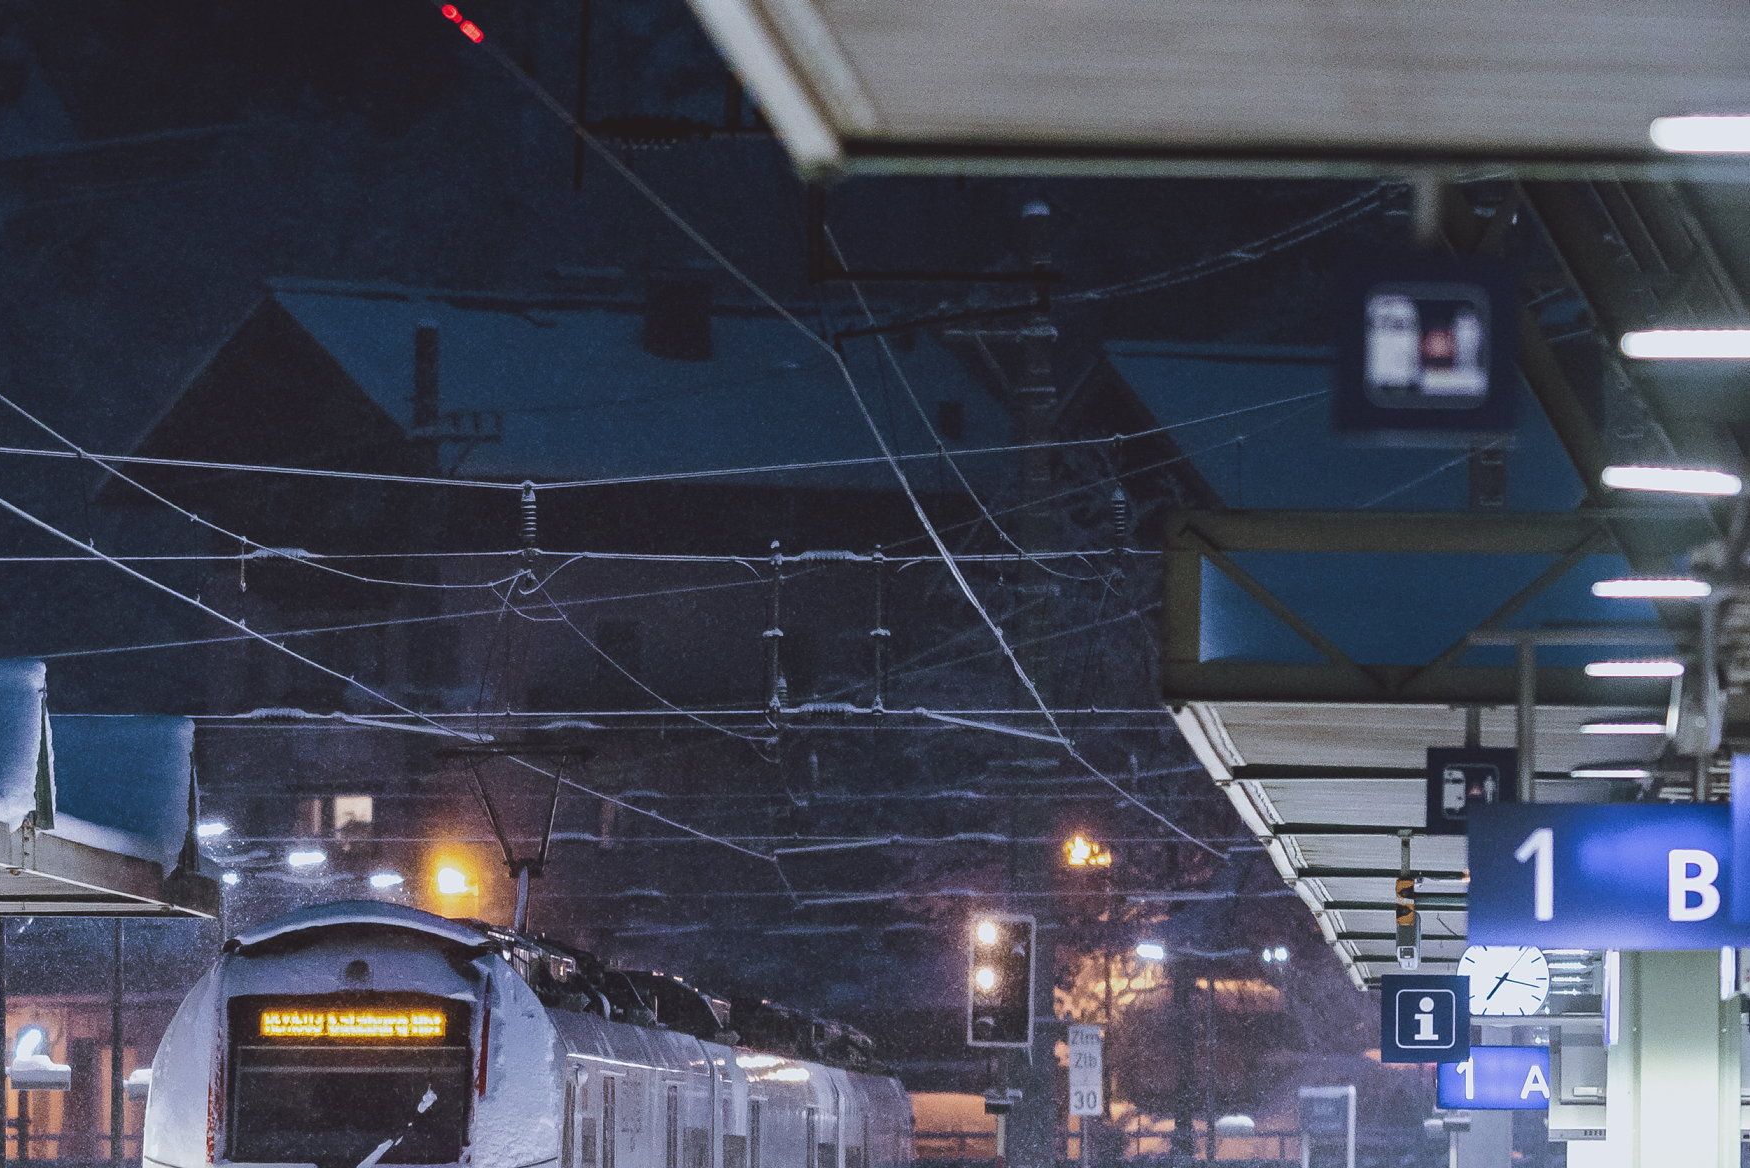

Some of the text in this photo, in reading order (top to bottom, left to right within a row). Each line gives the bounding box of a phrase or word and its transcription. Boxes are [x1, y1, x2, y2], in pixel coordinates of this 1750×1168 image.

[1514, 826, 1721, 921] 1 B
[1456, 1057, 1550, 1099] 1 A
[1073, 1090, 1097, 1110] 30
